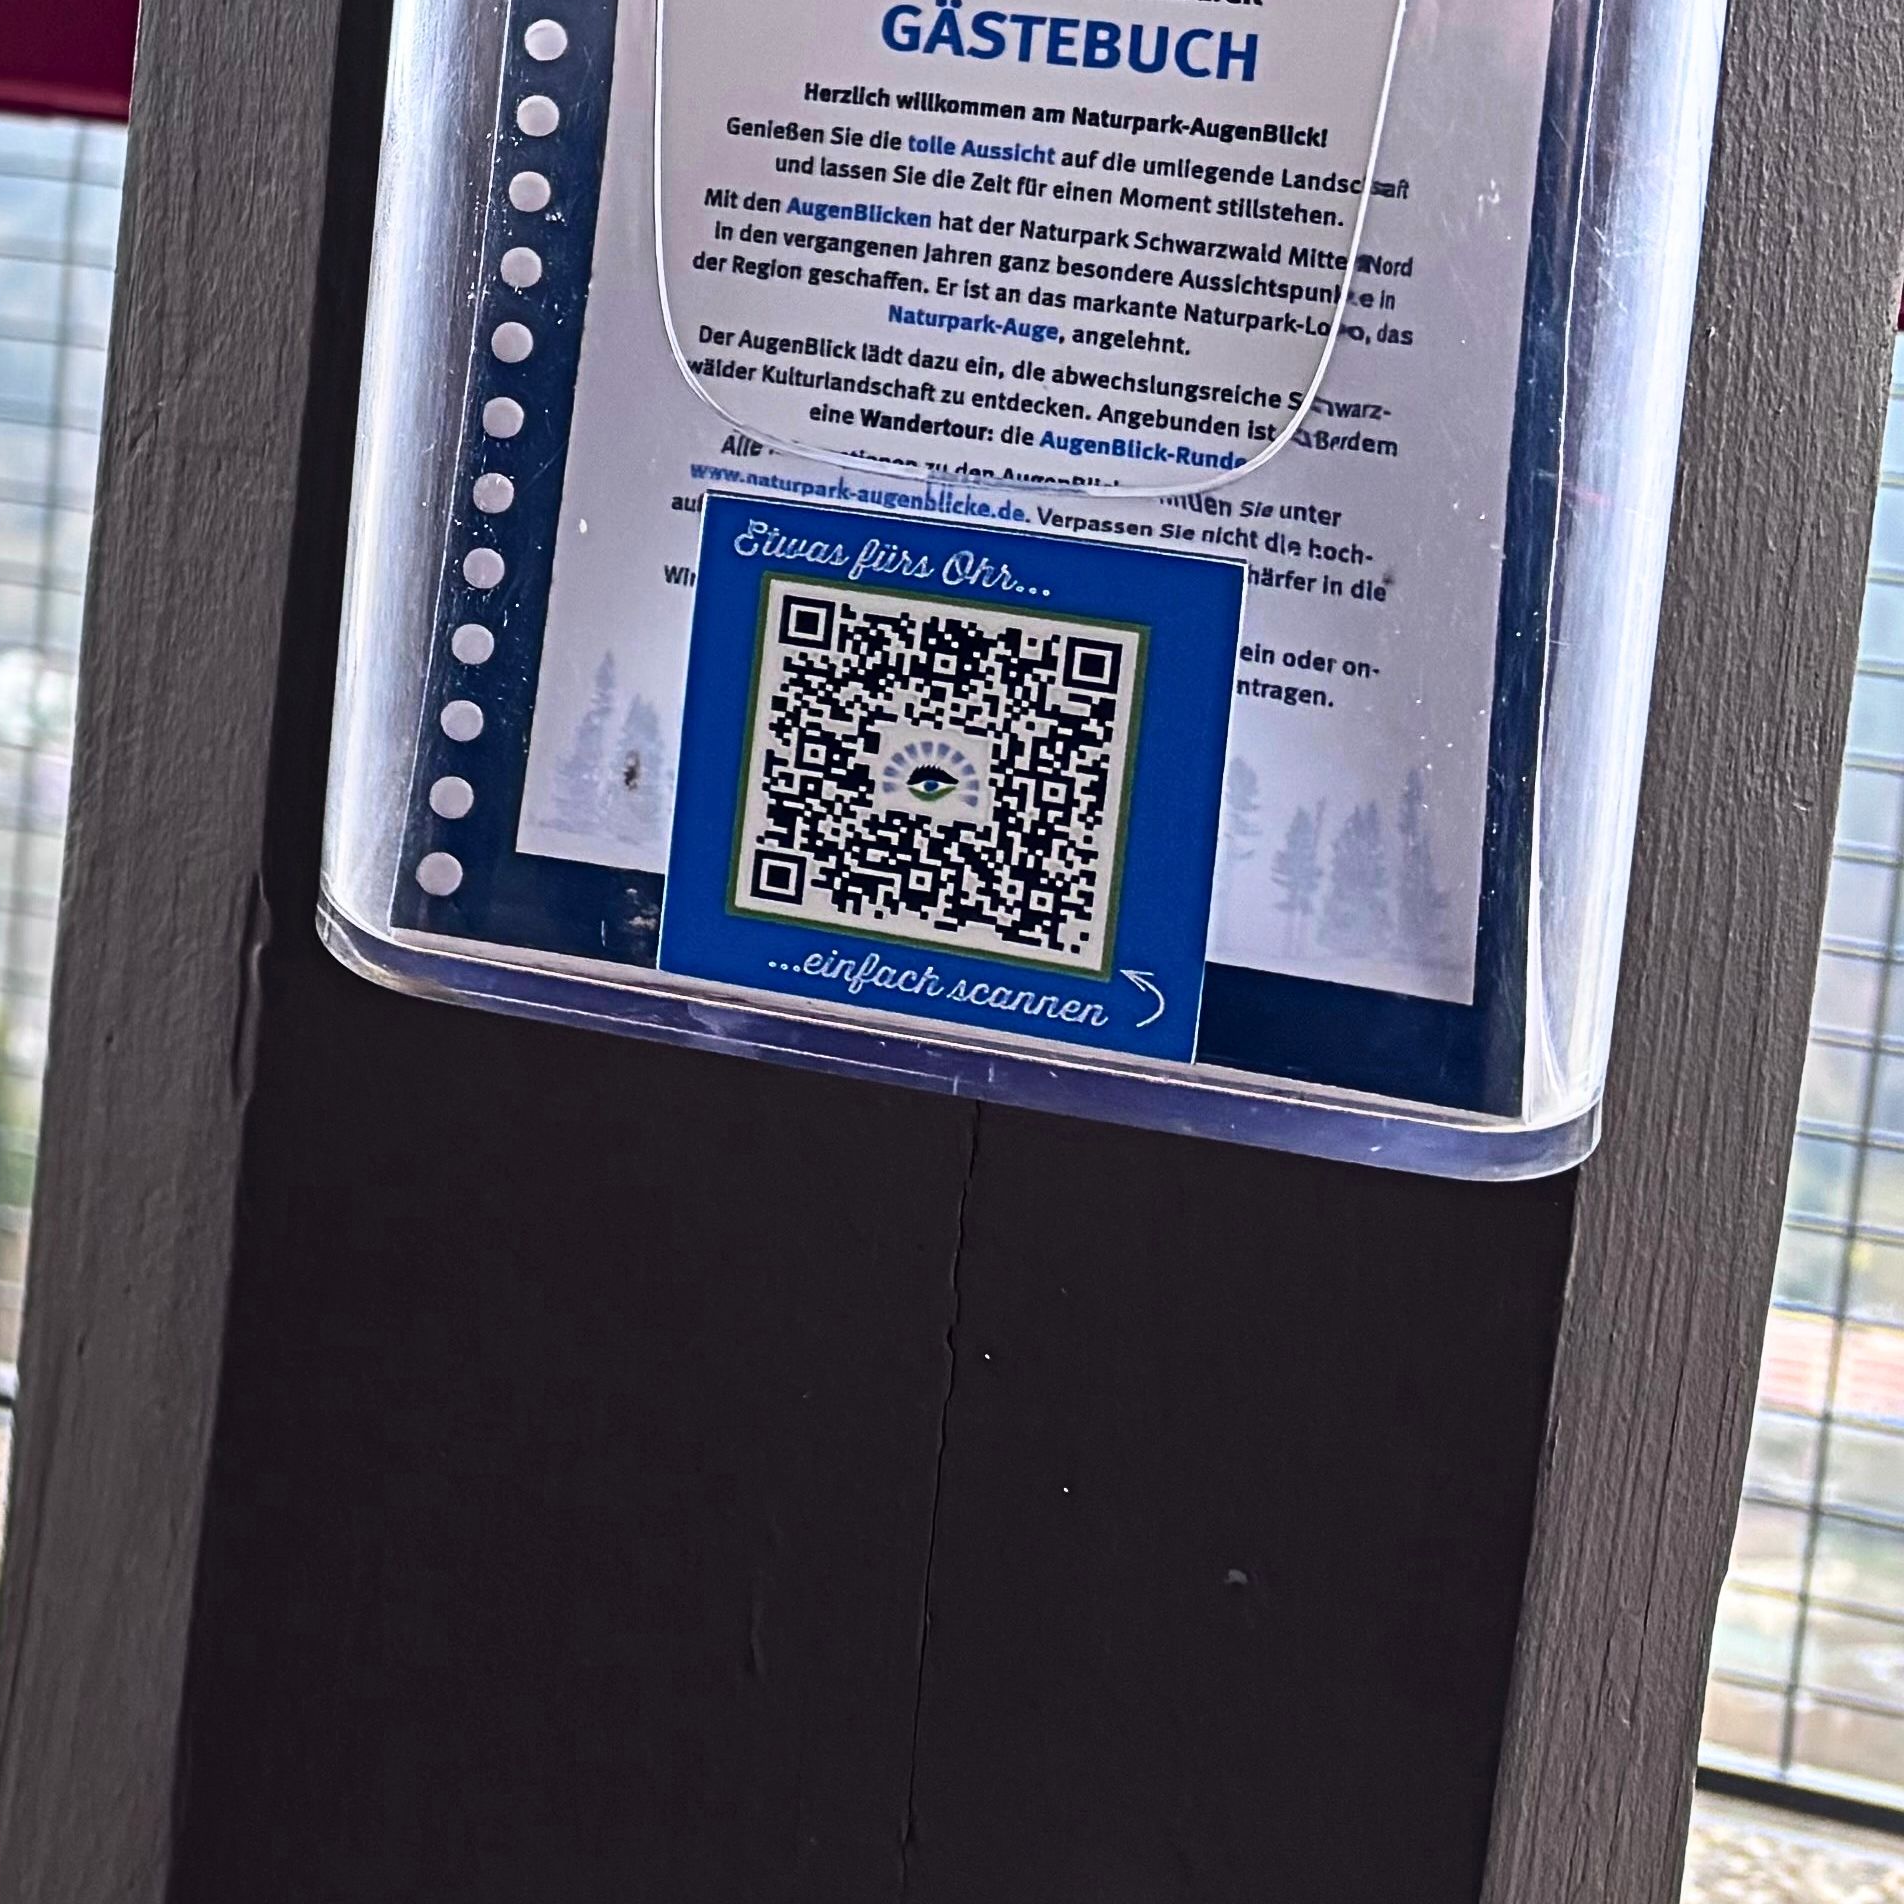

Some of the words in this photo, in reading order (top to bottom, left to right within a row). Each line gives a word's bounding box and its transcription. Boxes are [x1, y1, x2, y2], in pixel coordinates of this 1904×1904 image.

[804, 83, 890, 108] Herzlich
[896, 91, 1026, 120] willkommen
[1032, 107, 1065, 123] am
[1072, 107, 1328, 148] Naturpark-AugenBlick!
[726, 117, 824, 144] Genießen
[830, 127, 863, 147] Sie
[869, 130, 902, 151] die
[908, 134, 956, 155] tolle
[961, 140, 1055, 165] Aussicht
[1061, 151, 1099, 170] auf
[1102, 152, 1136, 173] die
[1143, 157, 1274, 185] umliegende
[1281, 168, 1410, 199] Landscaft
[775, 155, 814, 175] und
[820, 157, 886, 182] lassen
[893, 165, 926, 185] Sie
[933, 168, 965, 189] die
[971, 172, 1011, 194] Zeit
[1017, 176, 1047, 198] für
[1052, 181, 1113, 205] einen
[1120, 188, 1211, 214] Moment
[1216, 197, 1344, 227] stillstehen.
[704, 188, 738, 209] Mit
[743, 191, 780, 213] den
[786, 197, 931, 228] AugenBlicken
[939, 211, 973, 233] hat
[979, 215, 1015, 237] der
[1020, 219, 1130, 248] Naturpark
[1134, 231, 1281, 264] Schwarzwald
[1288, 246, 1413, 278] MitteNord
[714, 221, 733, 240] in
[740, 224, 777, 246] den
[783, 232, 917, 260] vergangenen
[923, 243, 992, 267] Jahren
[999, 255, 1050, 274] ganz
[1056, 256, 1174, 286] besondere
[1179, 269, 1373, 309] Aussichtspune
[1380, 290, 1396, 311] in
[692, 251, 727, 272] der
[732, 255, 802, 280] Region
[808, 265, 929, 294] geschaffen.
[936, 277, 958, 297] Er
[963, 279, 989, 301] ist
[995, 286, 1020, 304] an
[1028, 287, 1066, 309] das
[1073, 293, 1177, 321] markante
[1184, 303, 1371, 345] Naturpark-Loo,
[1376, 321, 1414, 346] das
[888, 304, 1065, 345] Naturpark-Auge,
[1072, 326, 1191, 356] angelehnt.
[699, 325, 735, 346] Der
[738, 328, 856, 361] AugenBlick
[862, 342, 902, 366] lädt
[908, 348, 958, 372] dazu
[965, 355, 1004, 380] ein,
[1012, 359, 1045, 382] die
[1051, 366, 1282, 410] abwechslungsreiche
[686, 357, 756, 383] wälder
[762, 364, 936, 402] Kulturlandschaft
[940, 387, 964, 406] zu
[971, 386, 1091, 422] entdecken.
[1097, 404, 1240, 438] Angebunden
[1247, 420, 1277, 442] ist
[809, 403, 854, 426] eine
[860, 408, 993, 442] Wandertour:
[1000, 426, 1034, 446] die
[1037, 506, 1153, 538] Verpassen
[1160, 524, 1195, 541] Sie
[1201, 524, 1258, 550] nicht
[1265, 532, 1301, 557] die
[1239, 500, 1274, 518] Sie
[1279, 504, 1343, 528] unter
[734, 518, 851, 566] Etwas
[848, 538, 935, 580] fürs
[1323, 572, 1343, 596] in
[1350, 581, 1387, 602] die
[1282, 647, 1337, 675] oder
[1342, 656, 1380, 679] on-
[946, 979, 1108, 1027] scannen
